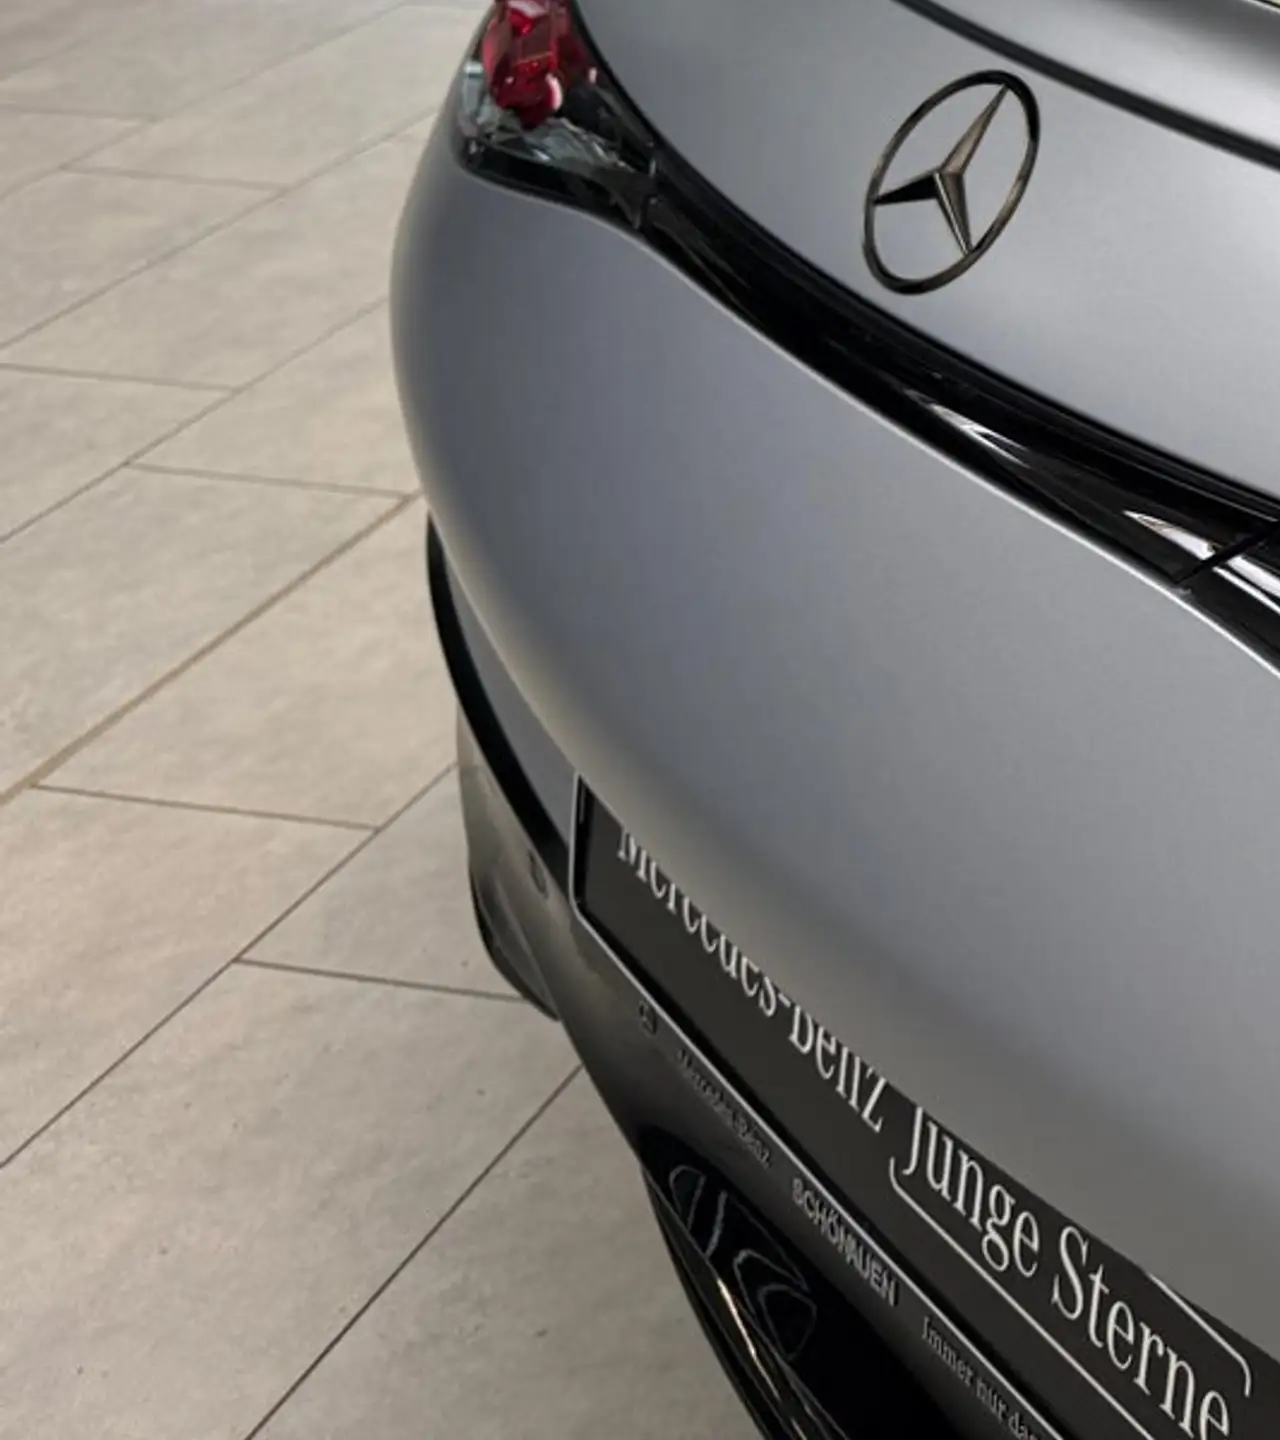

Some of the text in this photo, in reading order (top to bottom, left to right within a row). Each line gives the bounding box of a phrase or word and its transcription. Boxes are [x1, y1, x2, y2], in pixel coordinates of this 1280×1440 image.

[902, 1106, 1040, 1278] Junge
[1051, 1225, 1231, 1440] Sterne
[921, 1315, 974, 1387] Immer
